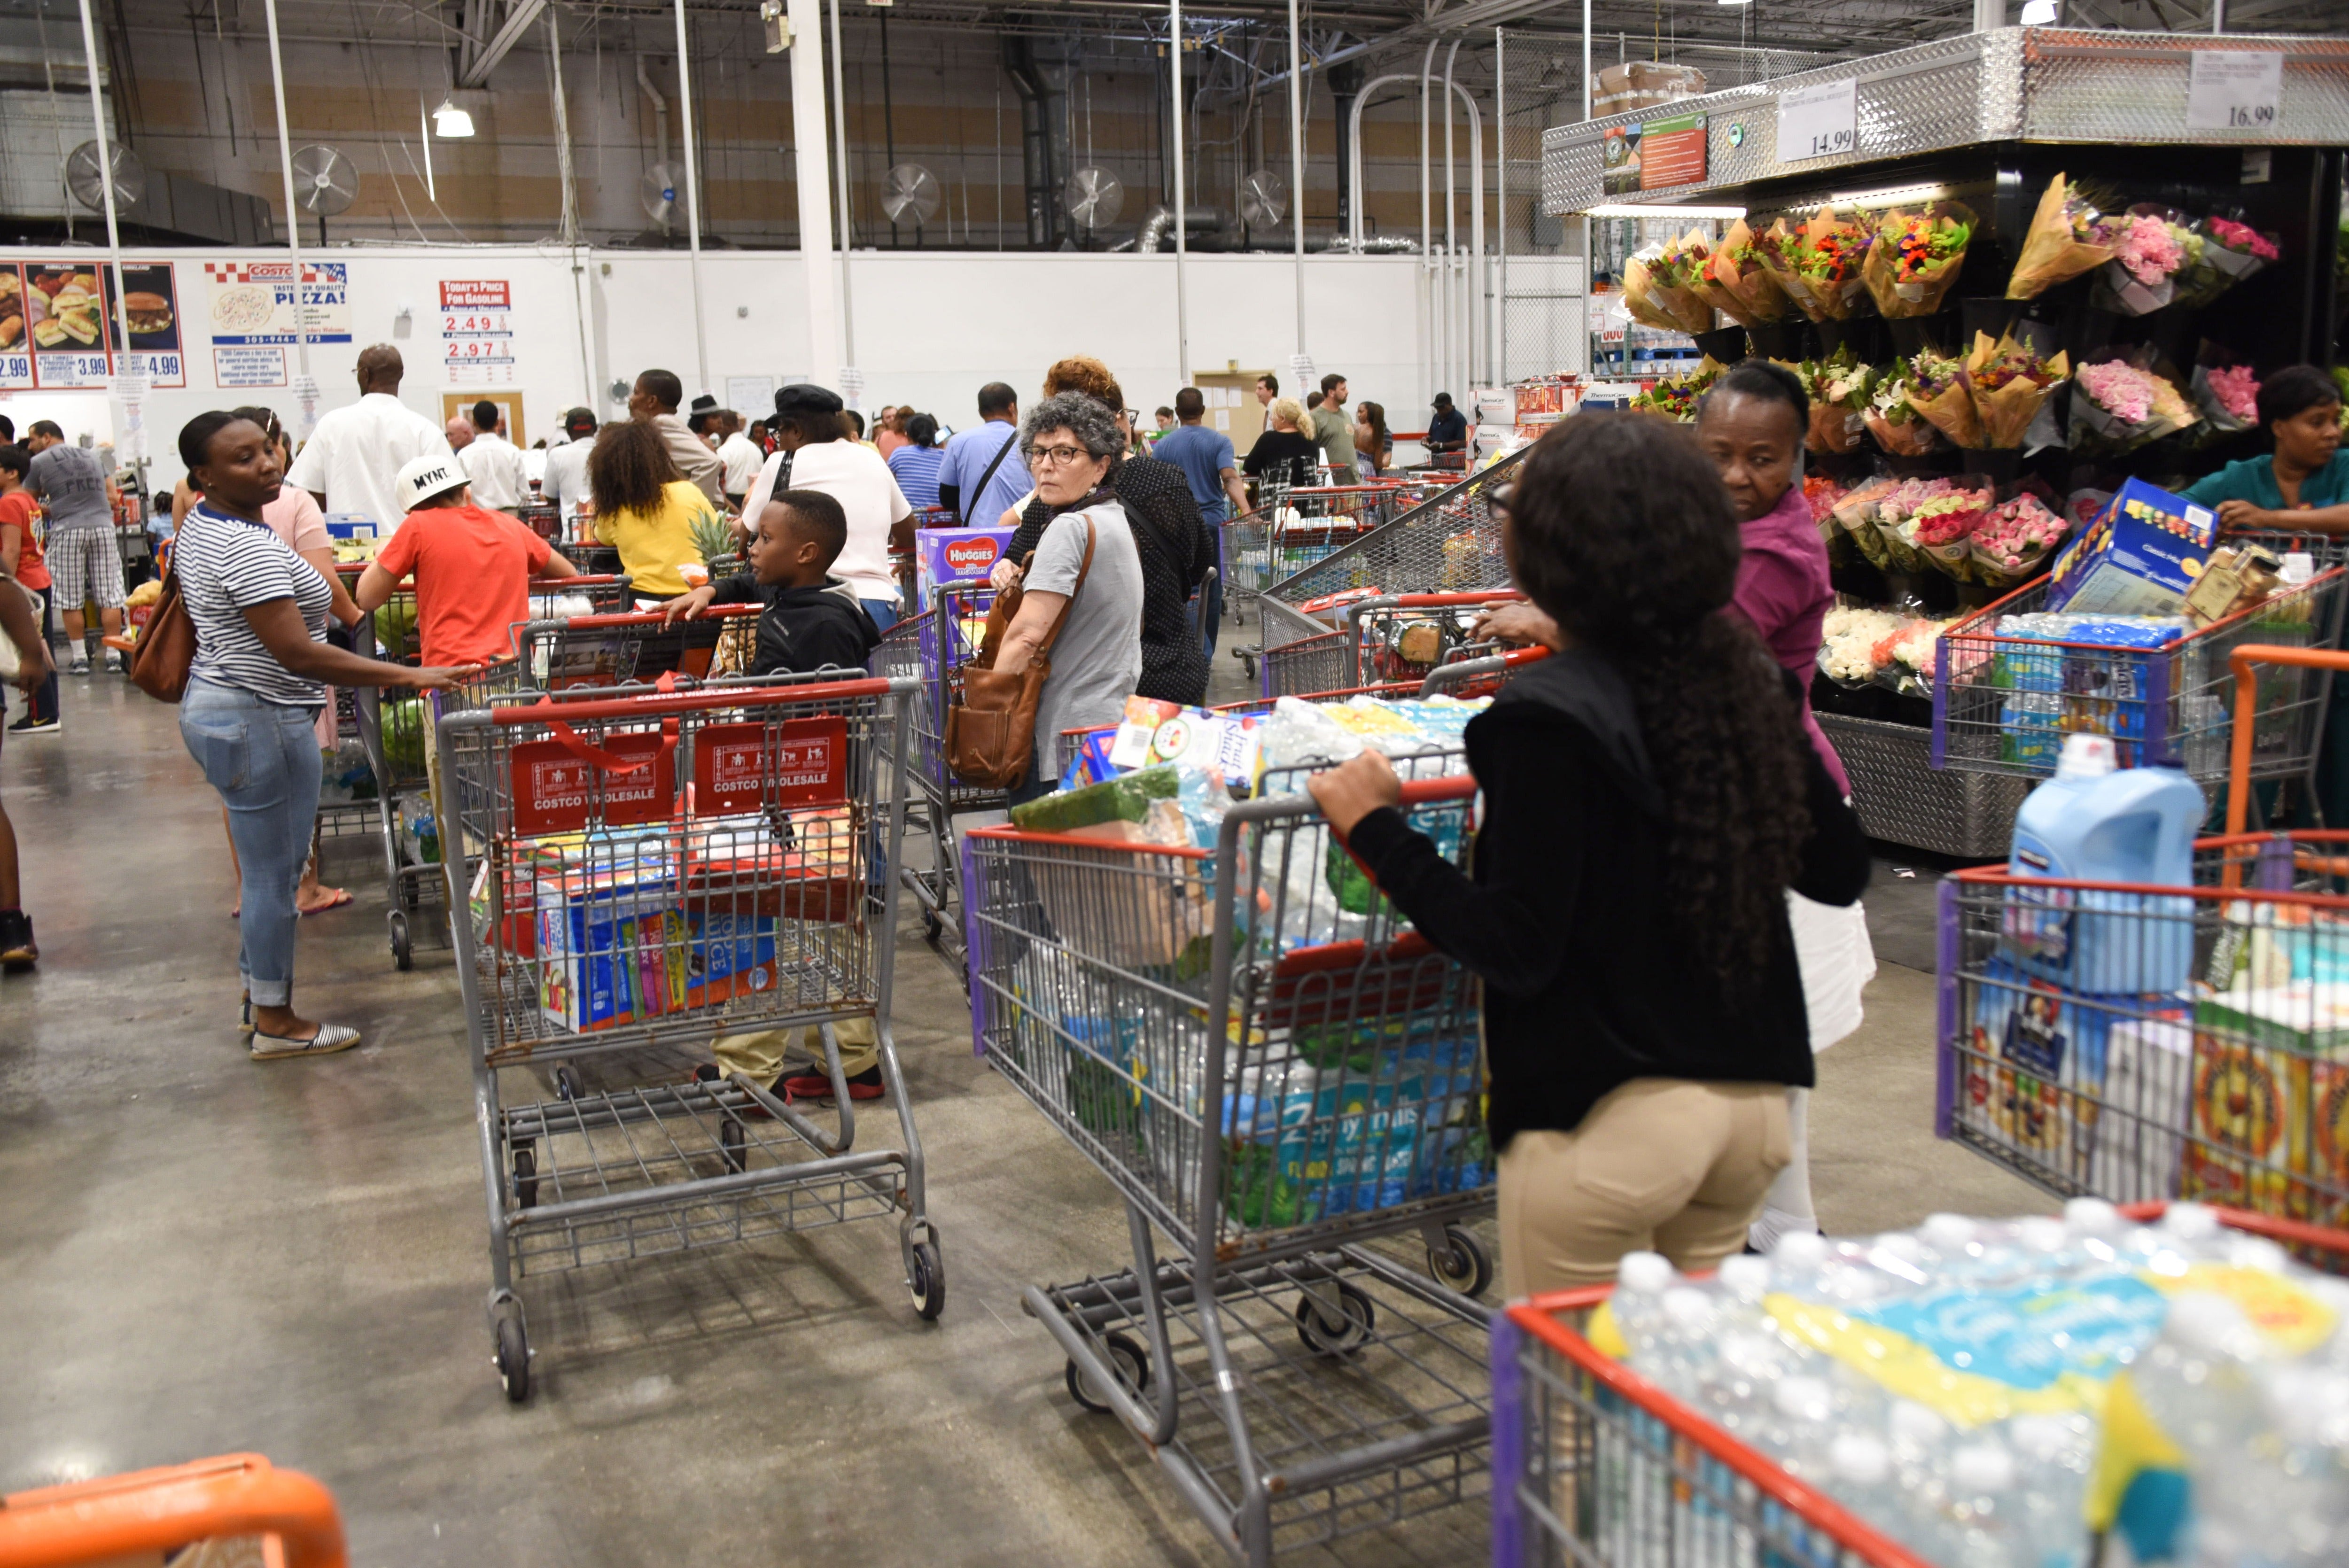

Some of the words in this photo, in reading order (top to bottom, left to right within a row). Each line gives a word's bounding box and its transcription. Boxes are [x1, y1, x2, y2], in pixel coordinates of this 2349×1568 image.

[2229, 106, 2274, 126] 16.99
[1812, 130, 1851, 155] 14.99
[250, 266, 303, 275] COSTC
[443, 282, 479, 292] TODAY'S
[480, 282, 505, 292] PRICE
[446, 293, 464, 304] FOR
[465, 293, 504, 304] GASOLINE
[78, 358, 106, 375] 3.99
[149, 357, 179, 375] 4.99
[50, 447, 90, 463] LIVE
[66, 477, 103, 494] FREE
[949, 549, 993, 562] HUGGIES
[956, 567, 988, 575] movers
[637, 692, 683, 701] COSTCO
[685, 687, 753, 698] WHOLESALE
[714, 780, 759, 792] COSTCO
[534, 796, 582, 810] COSTCO
[708, 913, 726, 971] JUCE
